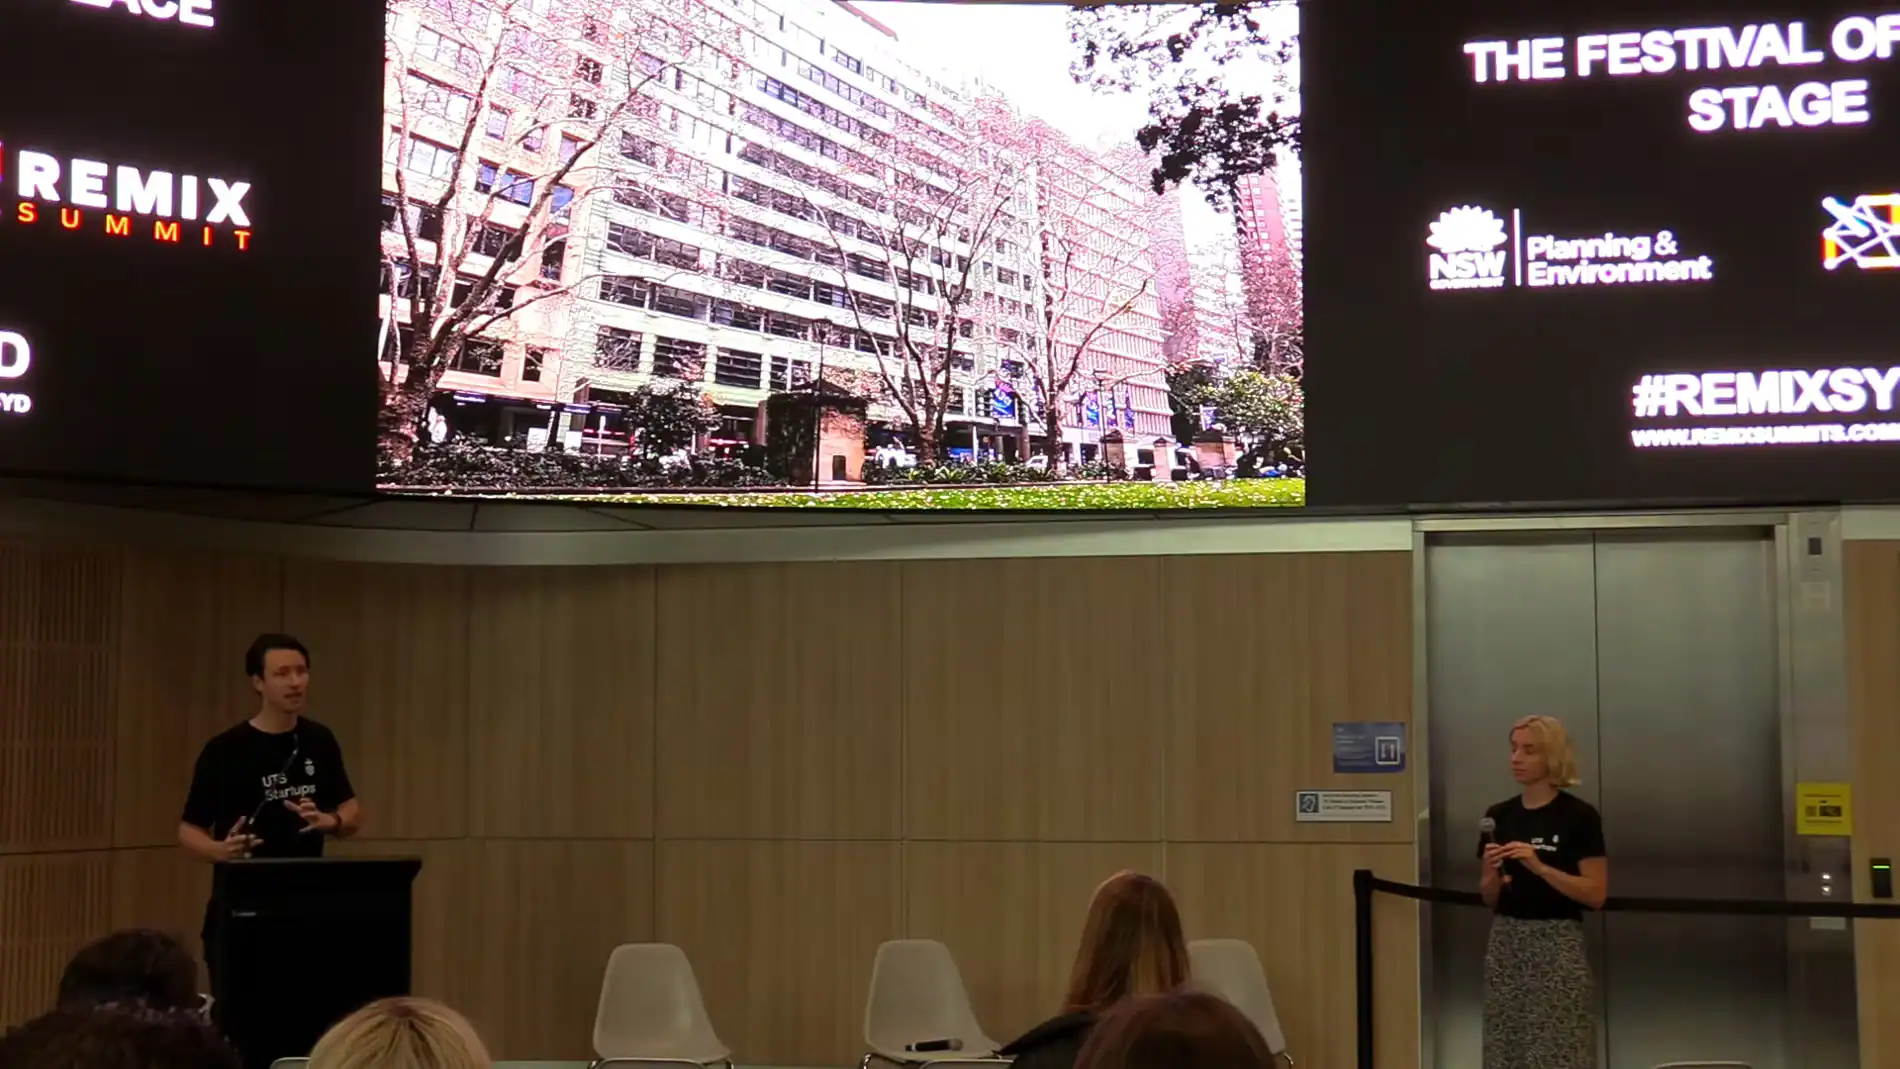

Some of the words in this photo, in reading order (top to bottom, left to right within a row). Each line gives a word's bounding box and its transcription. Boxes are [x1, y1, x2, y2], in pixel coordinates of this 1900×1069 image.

[1464, 38, 1565, 82] THE
[1577, 22, 1824, 76] FESTIVAL
[1832, 13, 1900, 61] OF
[1688, 80, 1869, 131] STAGE
[18, 149, 251, 226] REMIX
[17, 202, 251, 250] SUMMIT
[1527, 233, 1652, 260] Planning
[1653, 231, 1677, 255] &
[1429, 250, 1506, 278] NSW
[1528, 255, 1713, 286] Environment
[0, 393, 31, 413] YD
[264, 784, 317, 801] Startups
